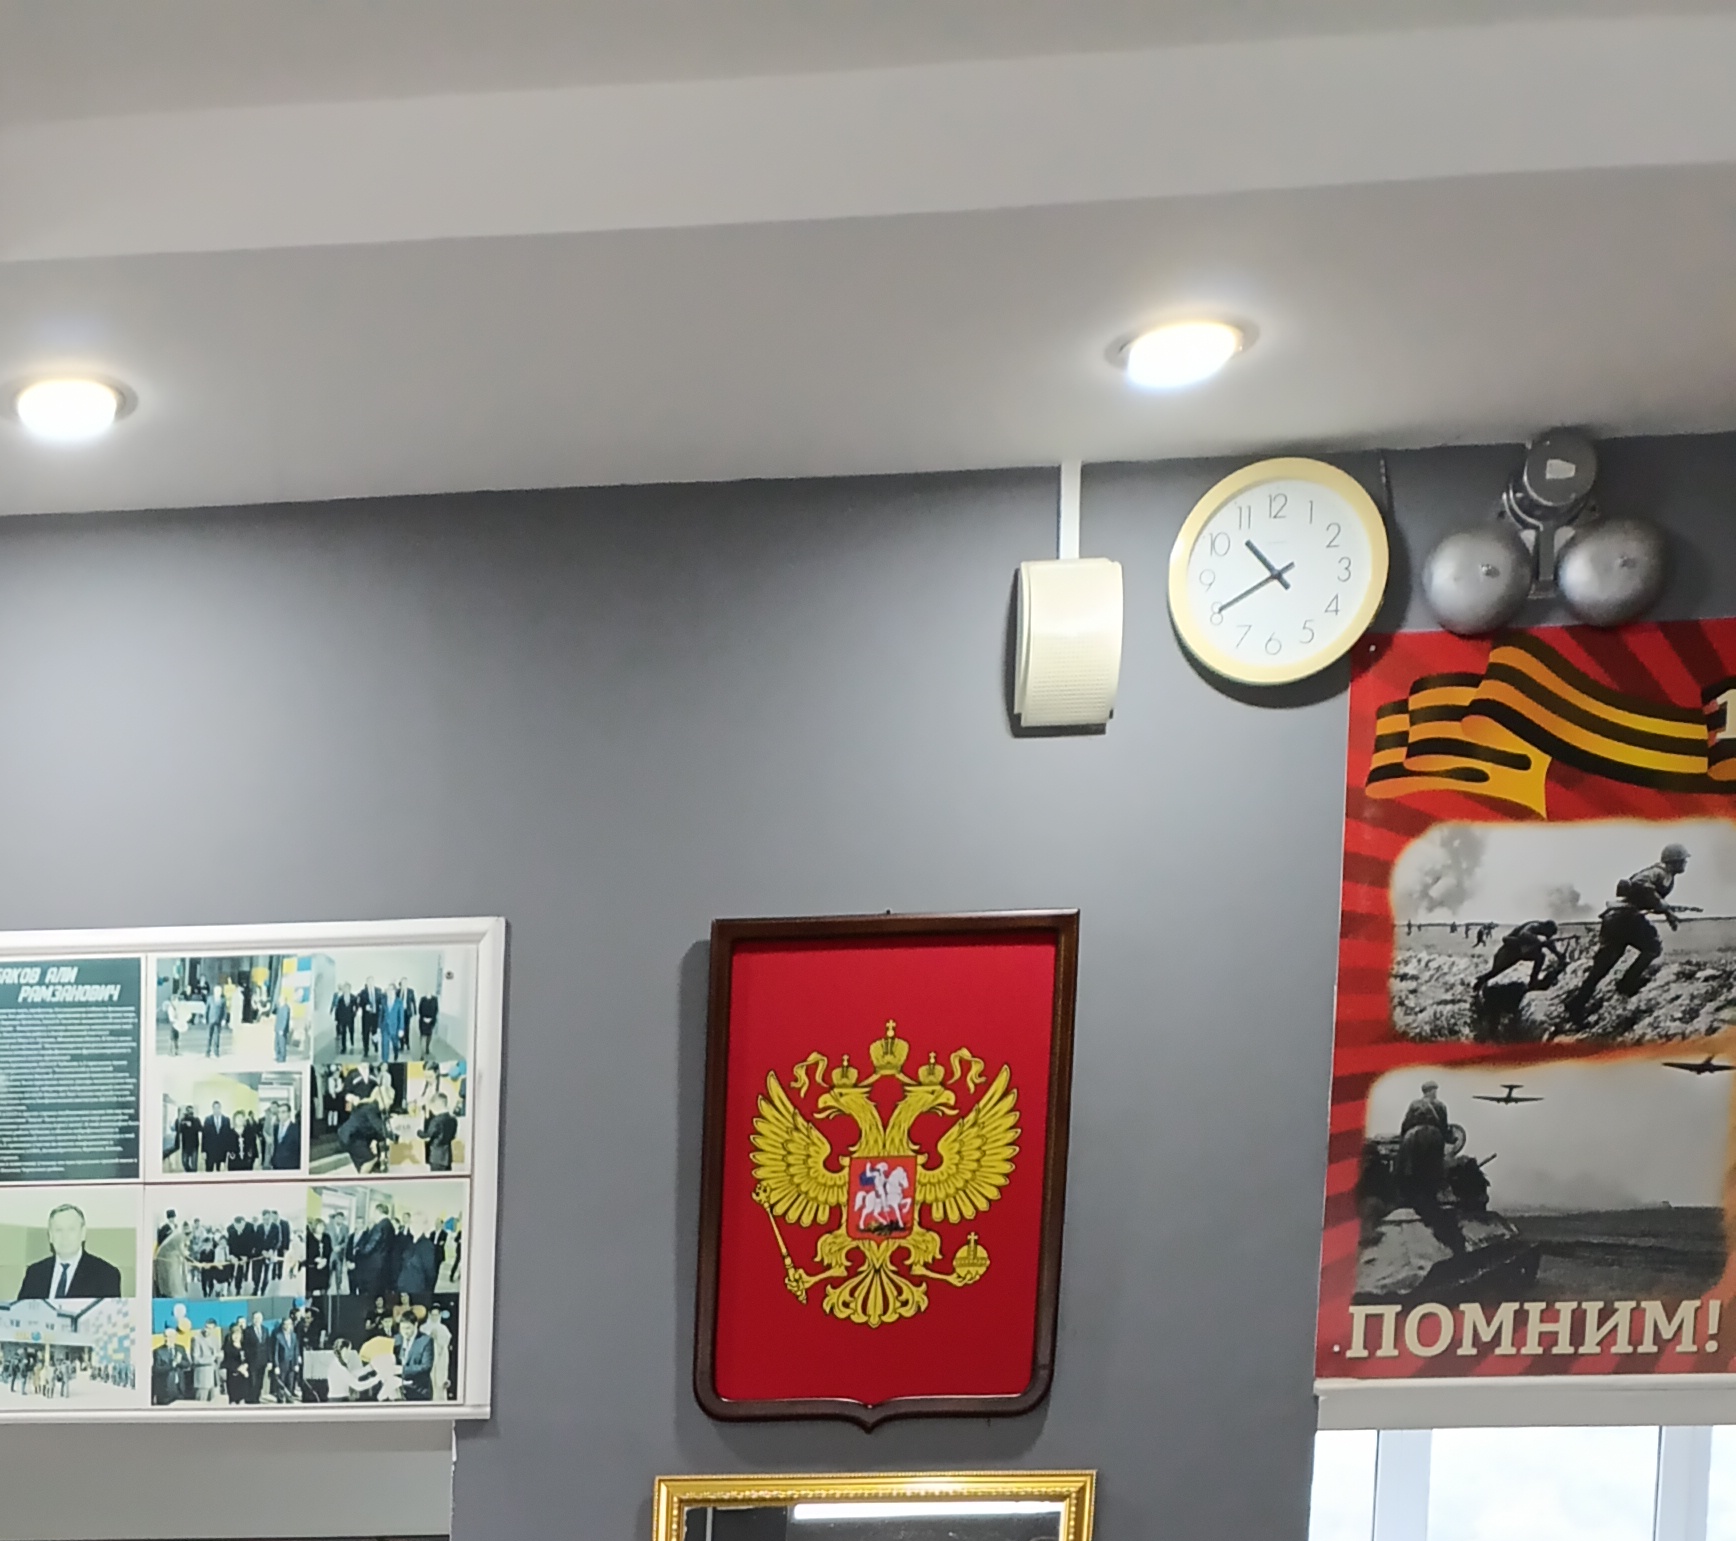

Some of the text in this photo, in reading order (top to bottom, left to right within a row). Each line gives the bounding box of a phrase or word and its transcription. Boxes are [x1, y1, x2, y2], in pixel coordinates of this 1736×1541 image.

[1239, 505, 1252, 530] 11
[1268, 493, 1288, 519] 12
[1309, 500, 1314, 524] 1
[1209, 531, 1231, 557] 10
[1325, 522, 1341, 548] 2
[1199, 569, 1216, 592] 9
[1337, 556, 1352, 582] 3
[1209, 601, 1224, 626] 8
[1324, 593, 1341, 616] 4
[1235, 624, 1252, 648] 7
[1264, 631, 1282, 655] 6
[1299, 619, 1315, 644] 5
[44, 965, 79, 984] АЛИ
[1345, 1299, 1722, 1359] ПОМНИМ!
